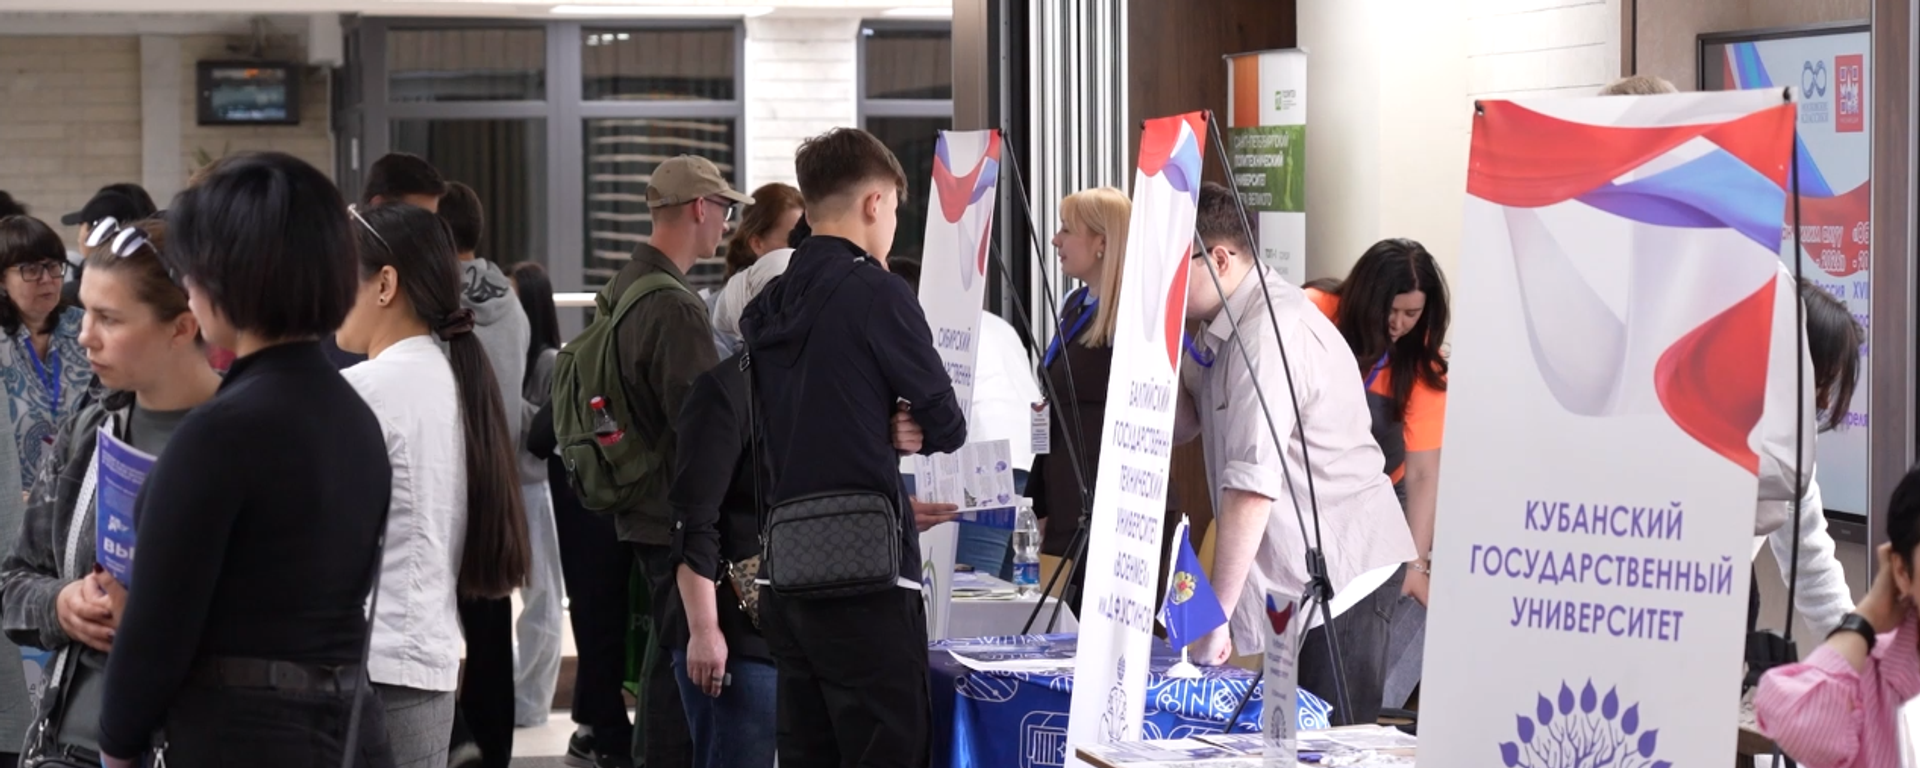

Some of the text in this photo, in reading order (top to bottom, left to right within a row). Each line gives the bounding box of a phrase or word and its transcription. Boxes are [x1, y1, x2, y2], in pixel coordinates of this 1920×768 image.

[1129, 377, 1171, 413] БАЛТИЙСКИЙ
[1119, 464, 1163, 500] ТЕХНИЧЕСКИЙ
[1115, 507, 1158, 545] УНИВЕРСИТЕТ
[1525, 500, 1683, 541] КУБАНСКИЙ
[1470, 544, 1733, 596] ГОСУДАРСТВЕННЫЙ
[1510, 596, 1684, 642] УНИВЕРСИТЕТ
